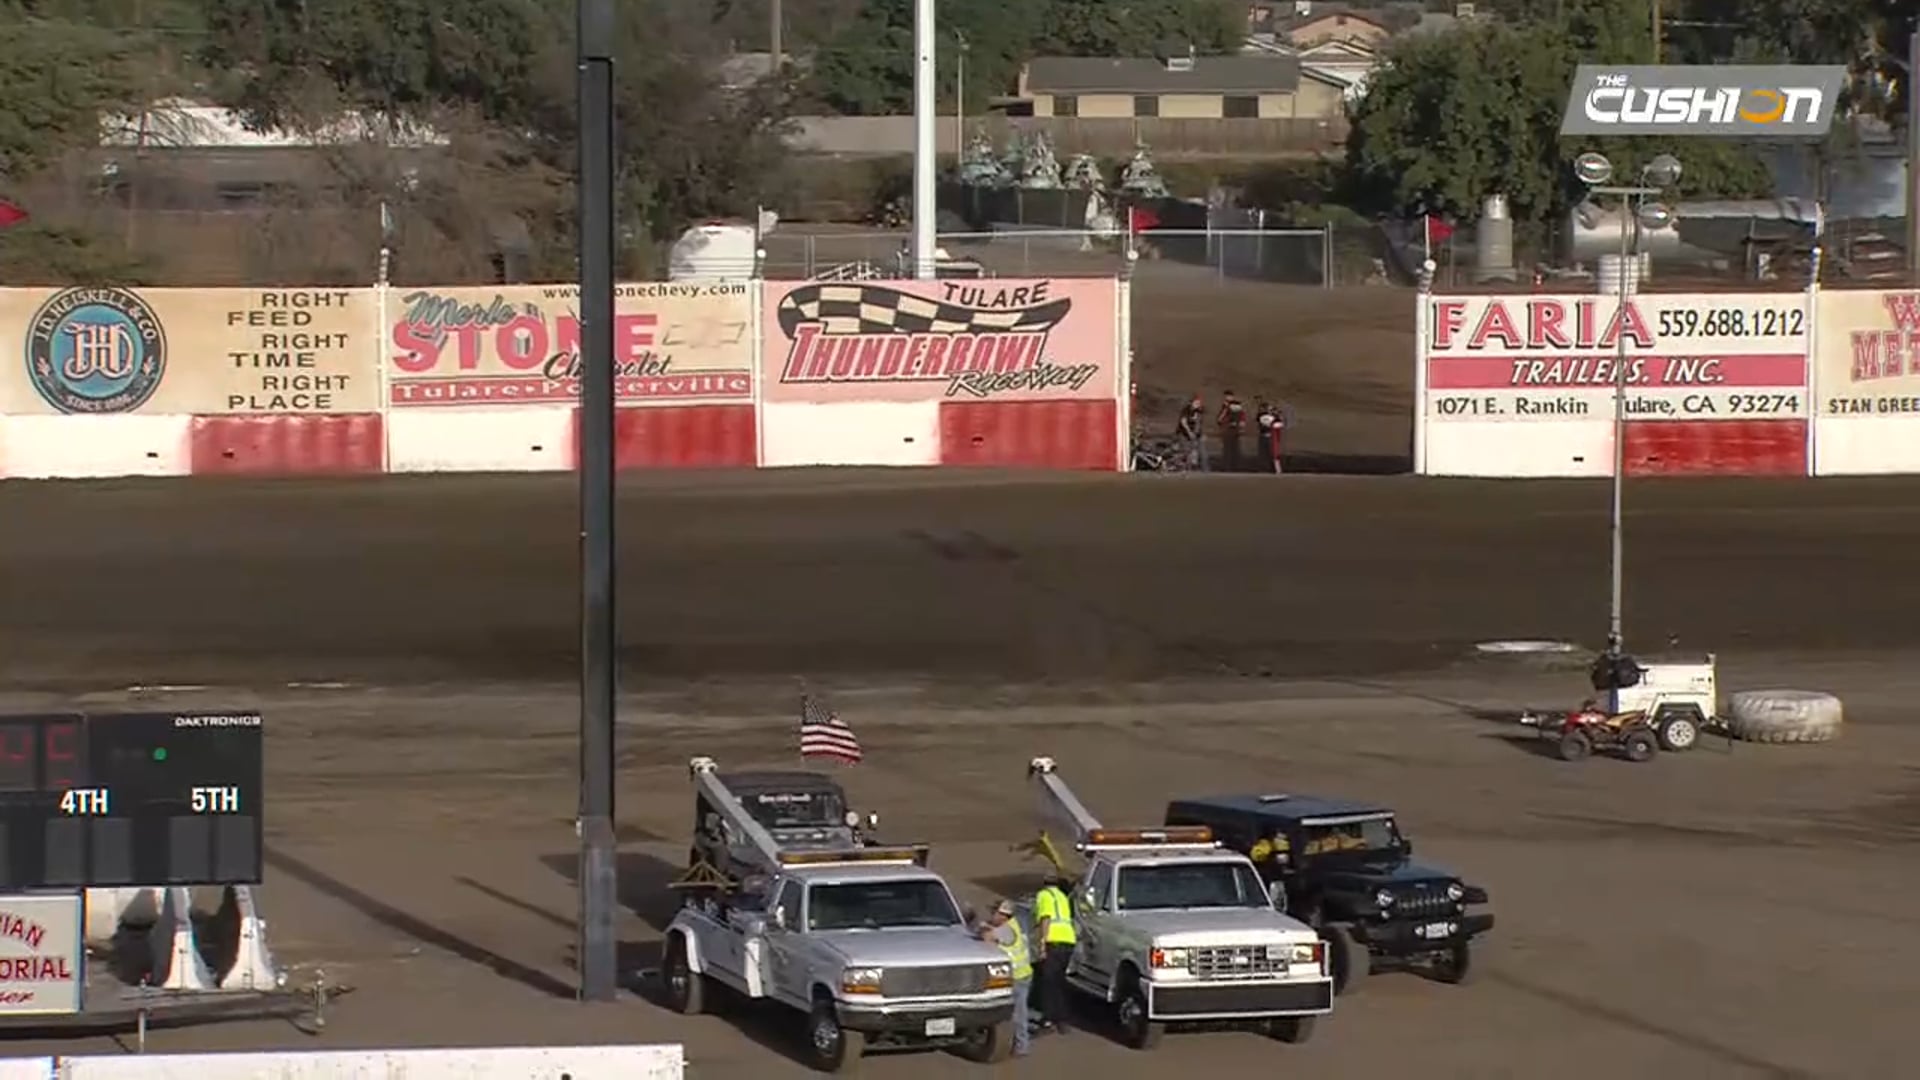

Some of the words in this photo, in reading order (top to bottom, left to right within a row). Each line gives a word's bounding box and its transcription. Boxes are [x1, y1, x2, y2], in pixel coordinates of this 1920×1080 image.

[262, 292, 350, 308] RIGHT
[543, 283, 746, 299] wwwonechevy.com
[944, 281, 1050, 308] TULARE
[228, 311, 312, 327] FEED
[1432, 299, 1654, 349] FARIA
[1658, 309, 1804, 336] 559.688.1212
[261, 333, 349, 349] RIGHT
[228, 352, 316, 368] TIME
[543, 349, 672, 380] Cholet
[1663, 358, 1725, 382] INC.
[262, 374, 351, 391] RIGHT
[543, 375, 748, 394] Poerville
[228, 394, 331, 410] PLACE
[1437, 398, 1478, 414] 1071
[1485, 398, 1504, 414] E.
[1516, 397, 1588, 414] Rankin
[1611, 395, 1676, 414] ulare,
[1683, 395, 1716, 412] CA
[1728, 395, 1799, 412] 93274
[1829, 398, 1871, 414] STAN
[60, 789, 108, 814] 4TH
[191, 787, 239, 812] 5TH
[0, 913, 45, 948] IAN
